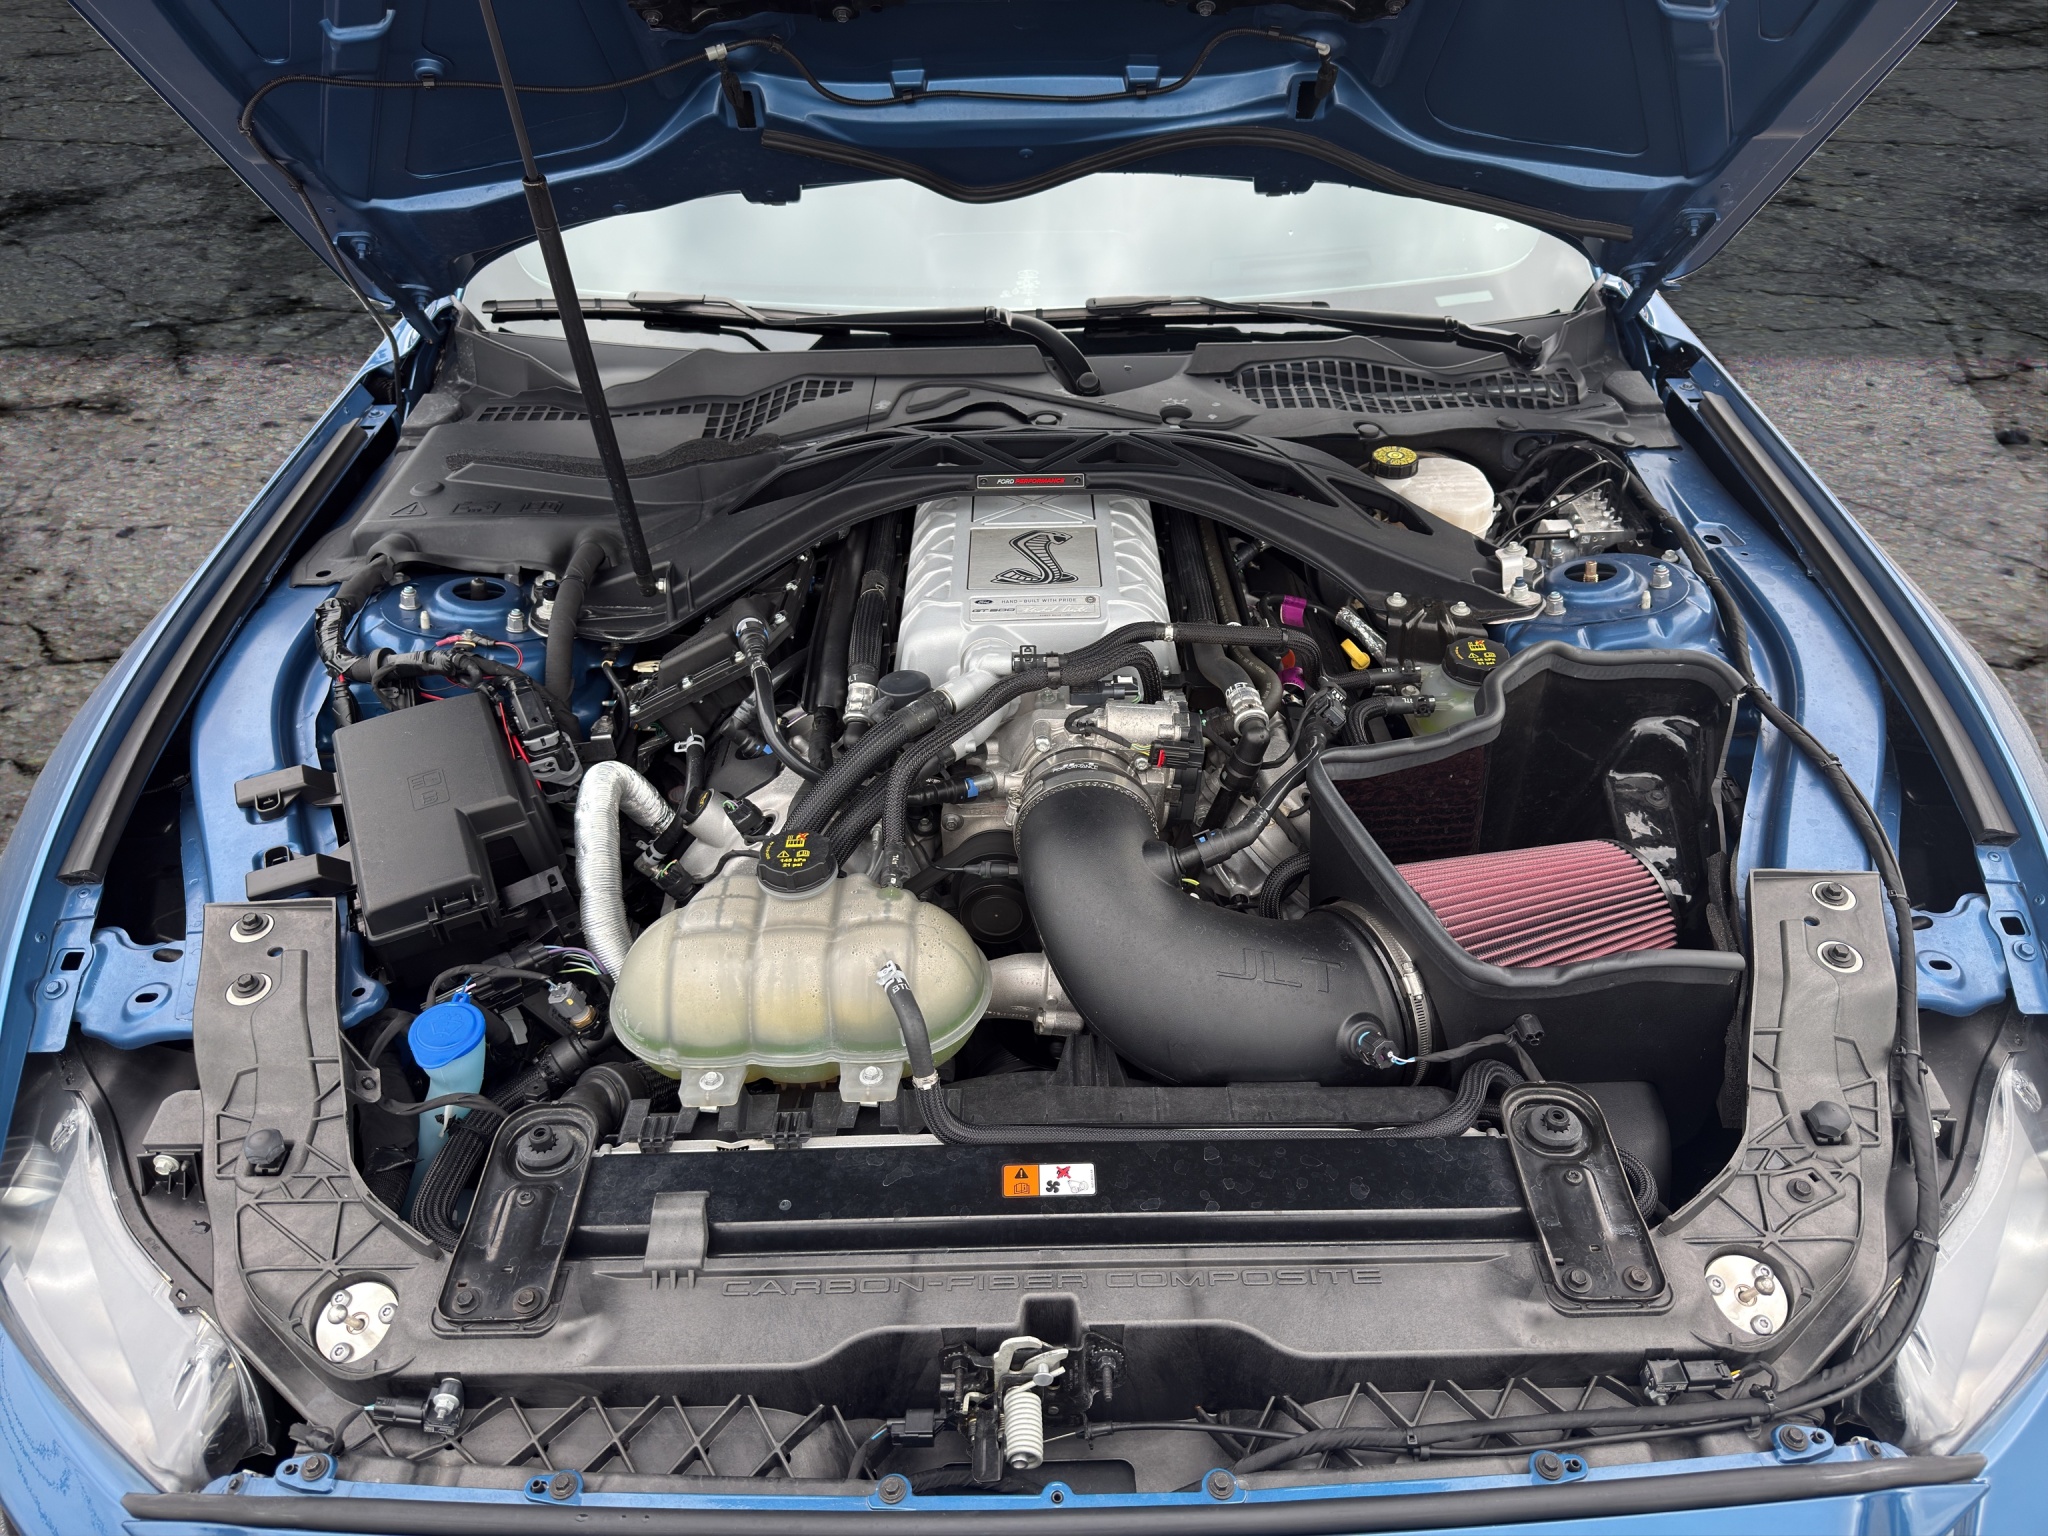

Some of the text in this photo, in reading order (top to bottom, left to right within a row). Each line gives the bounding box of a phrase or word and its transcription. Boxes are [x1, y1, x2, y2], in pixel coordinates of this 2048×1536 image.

[1216, 948, 1342, 994] JLT
[721, 1267, 1383, 1297] CARBON-FIBER COMPOSITE
